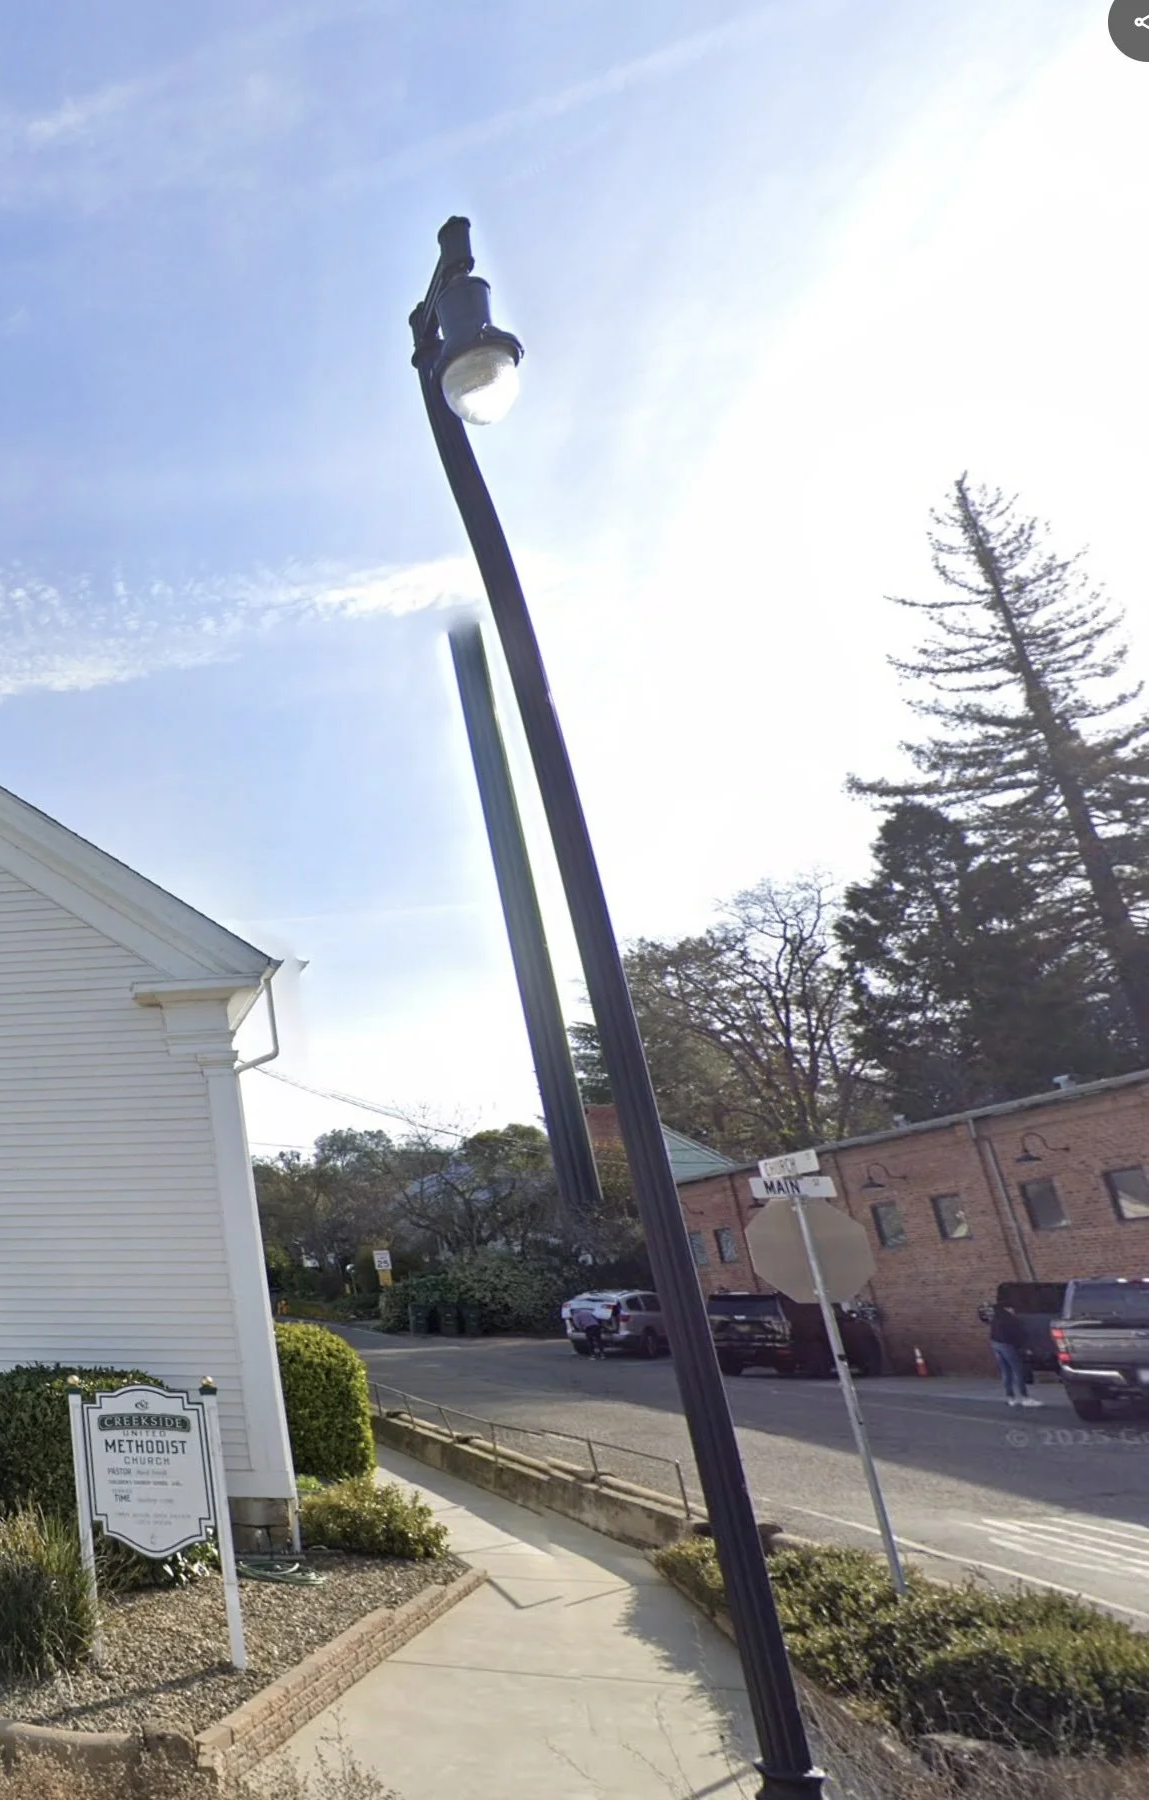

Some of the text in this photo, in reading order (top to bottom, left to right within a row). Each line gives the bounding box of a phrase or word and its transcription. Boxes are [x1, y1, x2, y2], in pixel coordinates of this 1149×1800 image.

[762, 1180, 801, 1195] MAIN
[104, 1416, 183, 1428] CREEKSIDE
[105, 1439, 187, 1454] METHODIST
[124, 1456, 170, 1465] CHURCH
[107, 1467, 131, 1475] PASTOR
[114, 1494, 131, 1502] TIME
